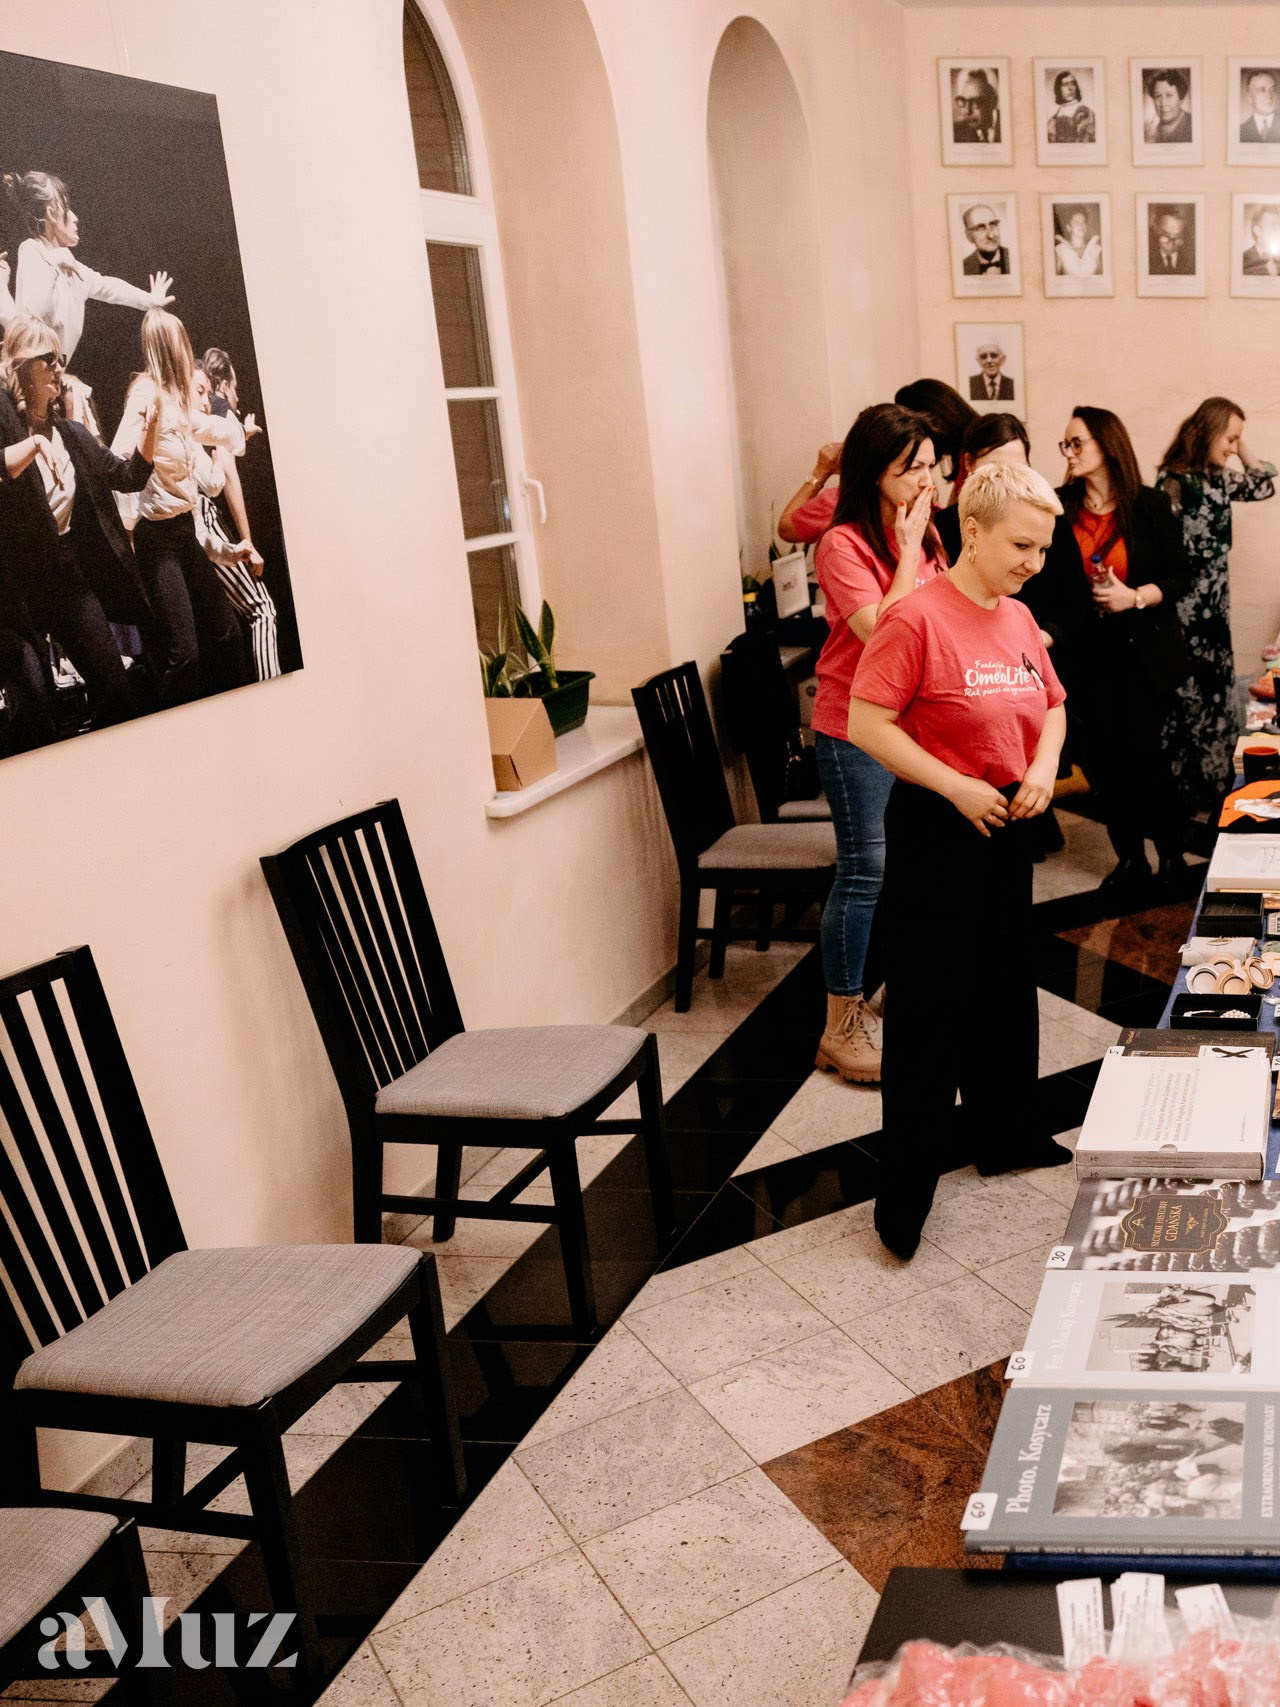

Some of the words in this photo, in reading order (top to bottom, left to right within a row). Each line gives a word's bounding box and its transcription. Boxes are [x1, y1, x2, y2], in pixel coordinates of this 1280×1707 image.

[1156, 1200, 1168, 1224] HISTORIE
[1165, 1204, 1182, 1242] GDAŃSKA
[1151, 1224, 1164, 1247] SŁODKIE
[1052, 1251, 1066, 1262] 30
[1011, 1356, 1026, 1371] 60
[1018, 1404, 1052, 1462] Kosycarz
[1264, 1404, 1274, 1445] ORDINARY
[1005, 1466, 1038, 1514] Photo.
[1261, 1446, 1274, 1518] EXTRAORDINARY
[970, 1502, 986, 1518] 60
